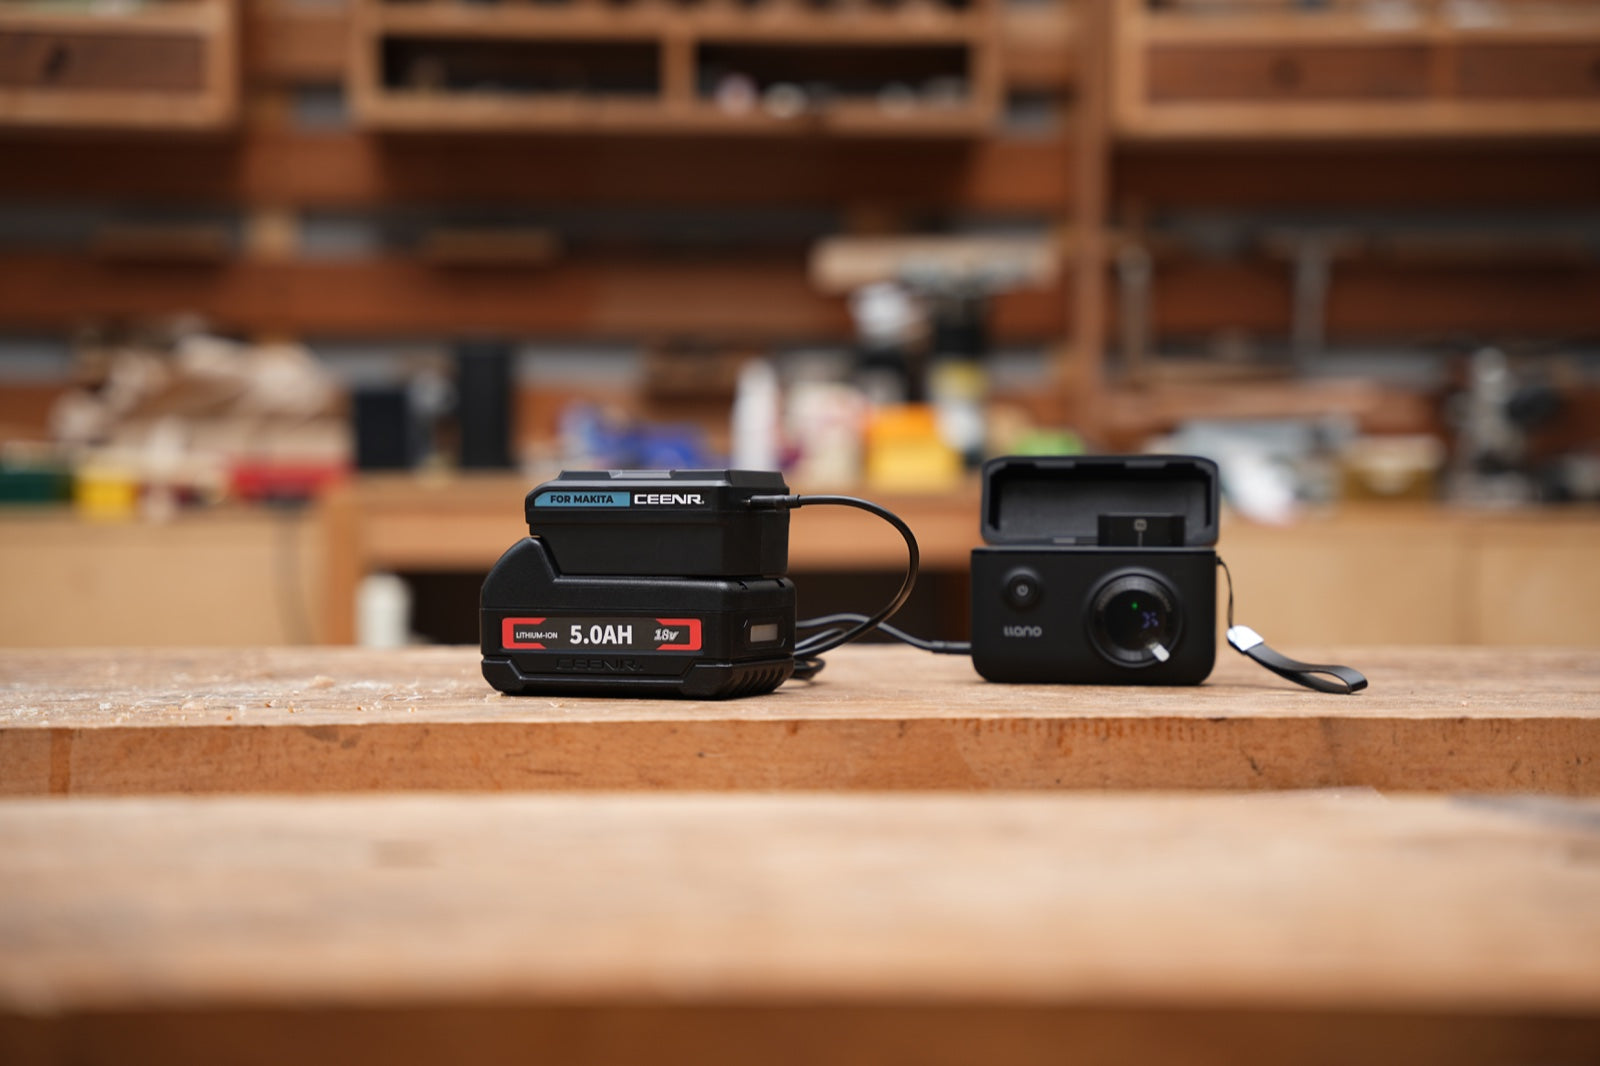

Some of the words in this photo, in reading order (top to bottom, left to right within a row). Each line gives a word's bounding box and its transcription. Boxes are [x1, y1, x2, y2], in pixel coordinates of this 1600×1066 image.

[550, 494, 570, 505] FOR
[573, 494, 614, 505] MAKITA
[515, 631, 558, 640] LITHIUM-ION
[569, 624, 633, 645] 5.0AH
